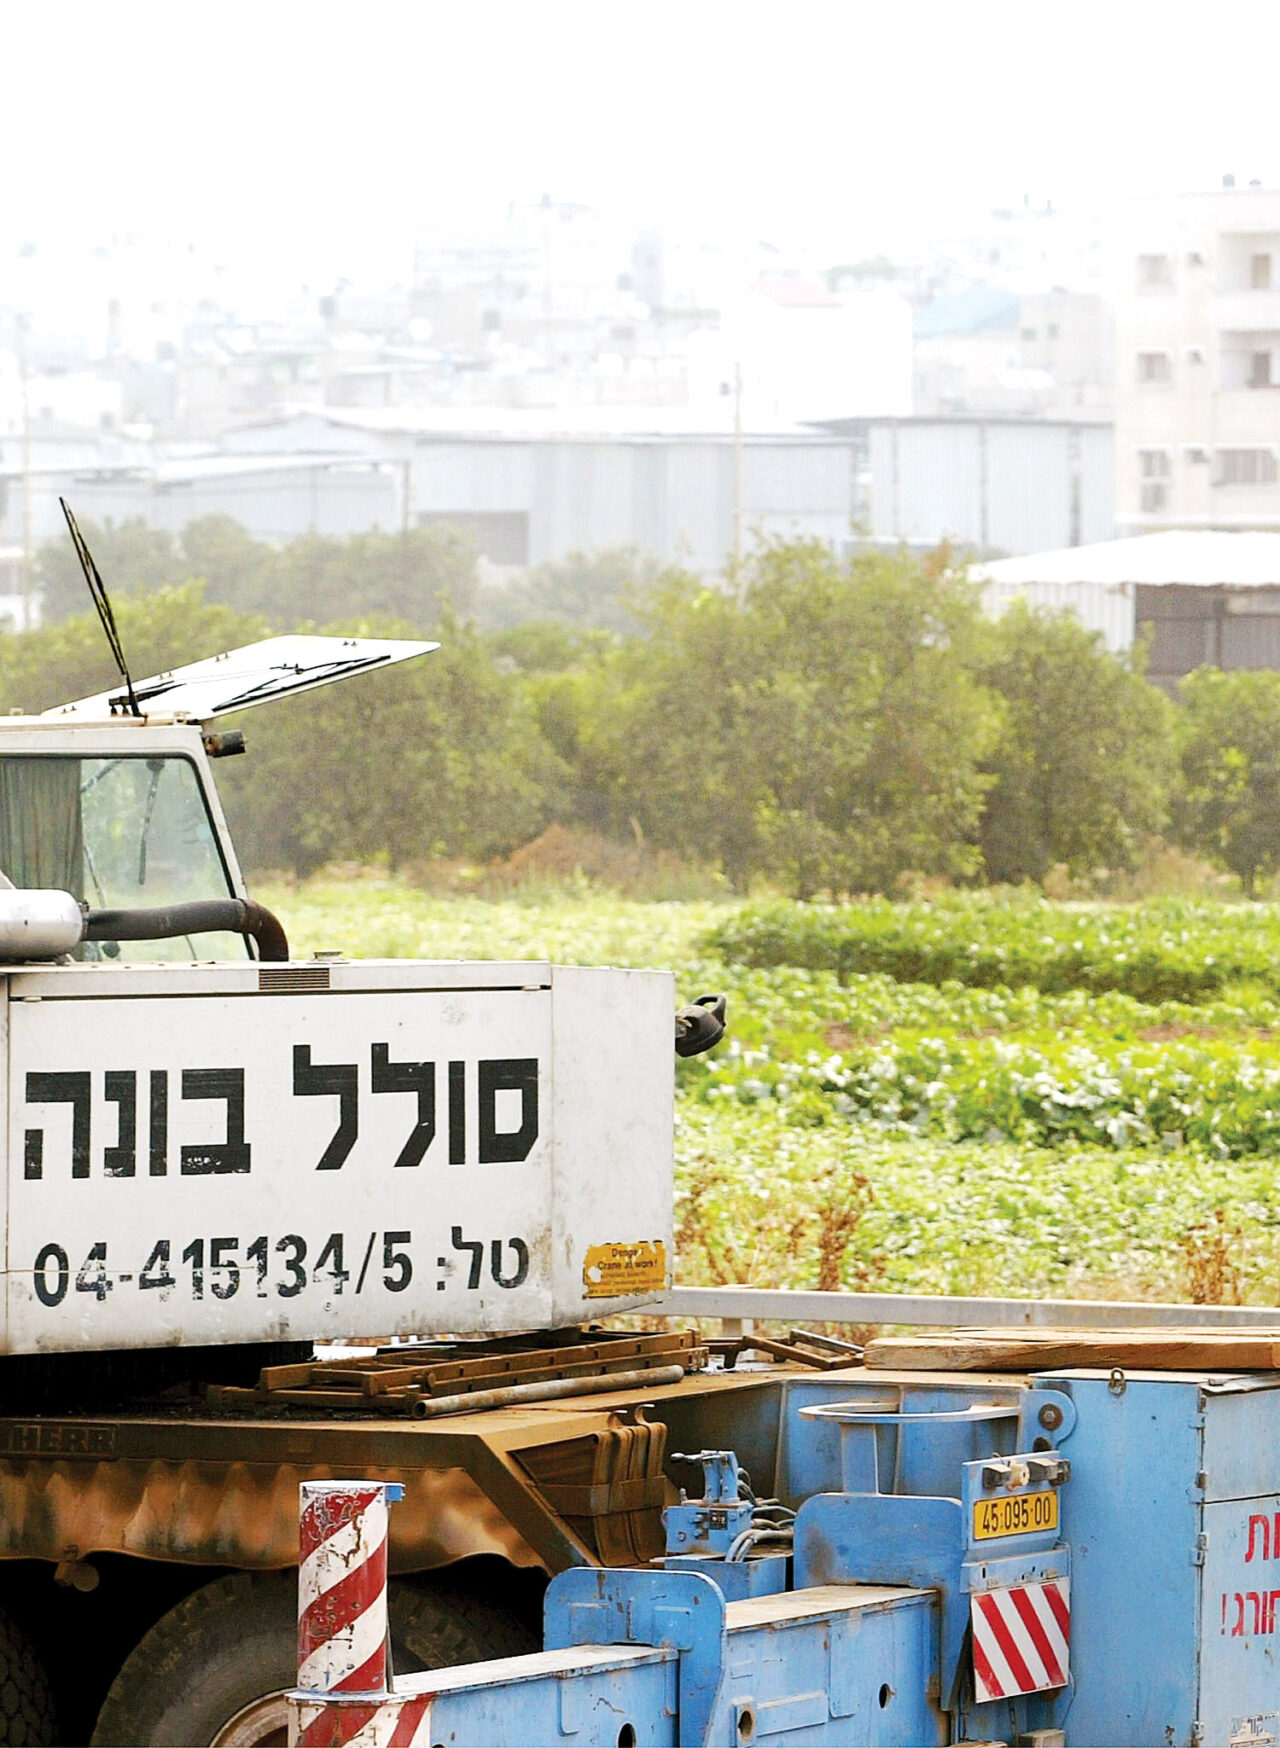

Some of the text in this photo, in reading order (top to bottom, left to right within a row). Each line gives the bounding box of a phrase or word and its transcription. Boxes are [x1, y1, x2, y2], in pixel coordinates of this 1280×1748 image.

[24, 1042, 539, 1180] סולל בונה
[33, 1230, 413, 1307] 04-415134/5
[0, 1426, 114, 1454] HERR
